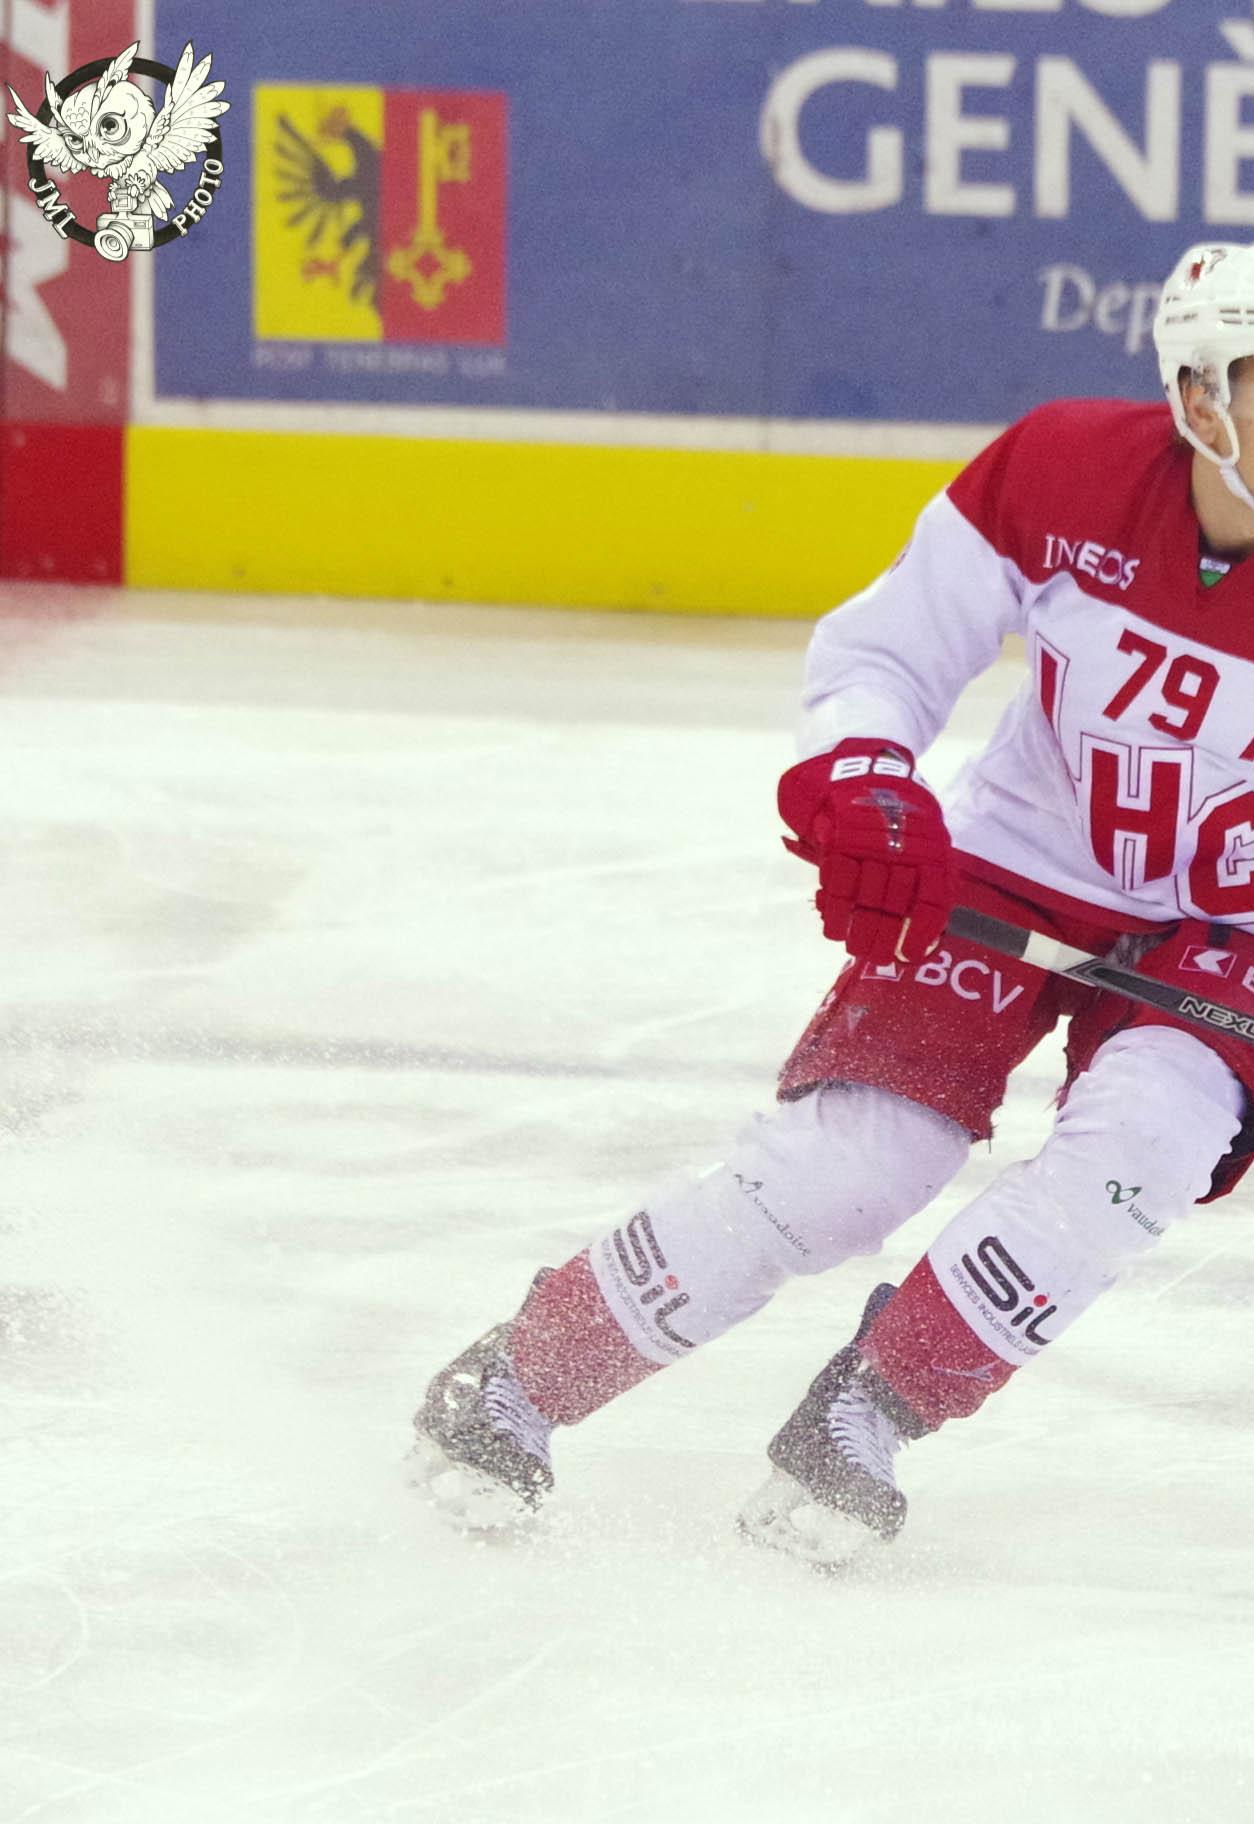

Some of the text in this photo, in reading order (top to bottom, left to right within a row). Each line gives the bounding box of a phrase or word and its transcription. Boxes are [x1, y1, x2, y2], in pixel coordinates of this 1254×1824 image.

[1043, 535, 1140, 590] INEOS
[1102, 628, 1221, 742] 79
[914, 950, 1025, 1014] BCV
